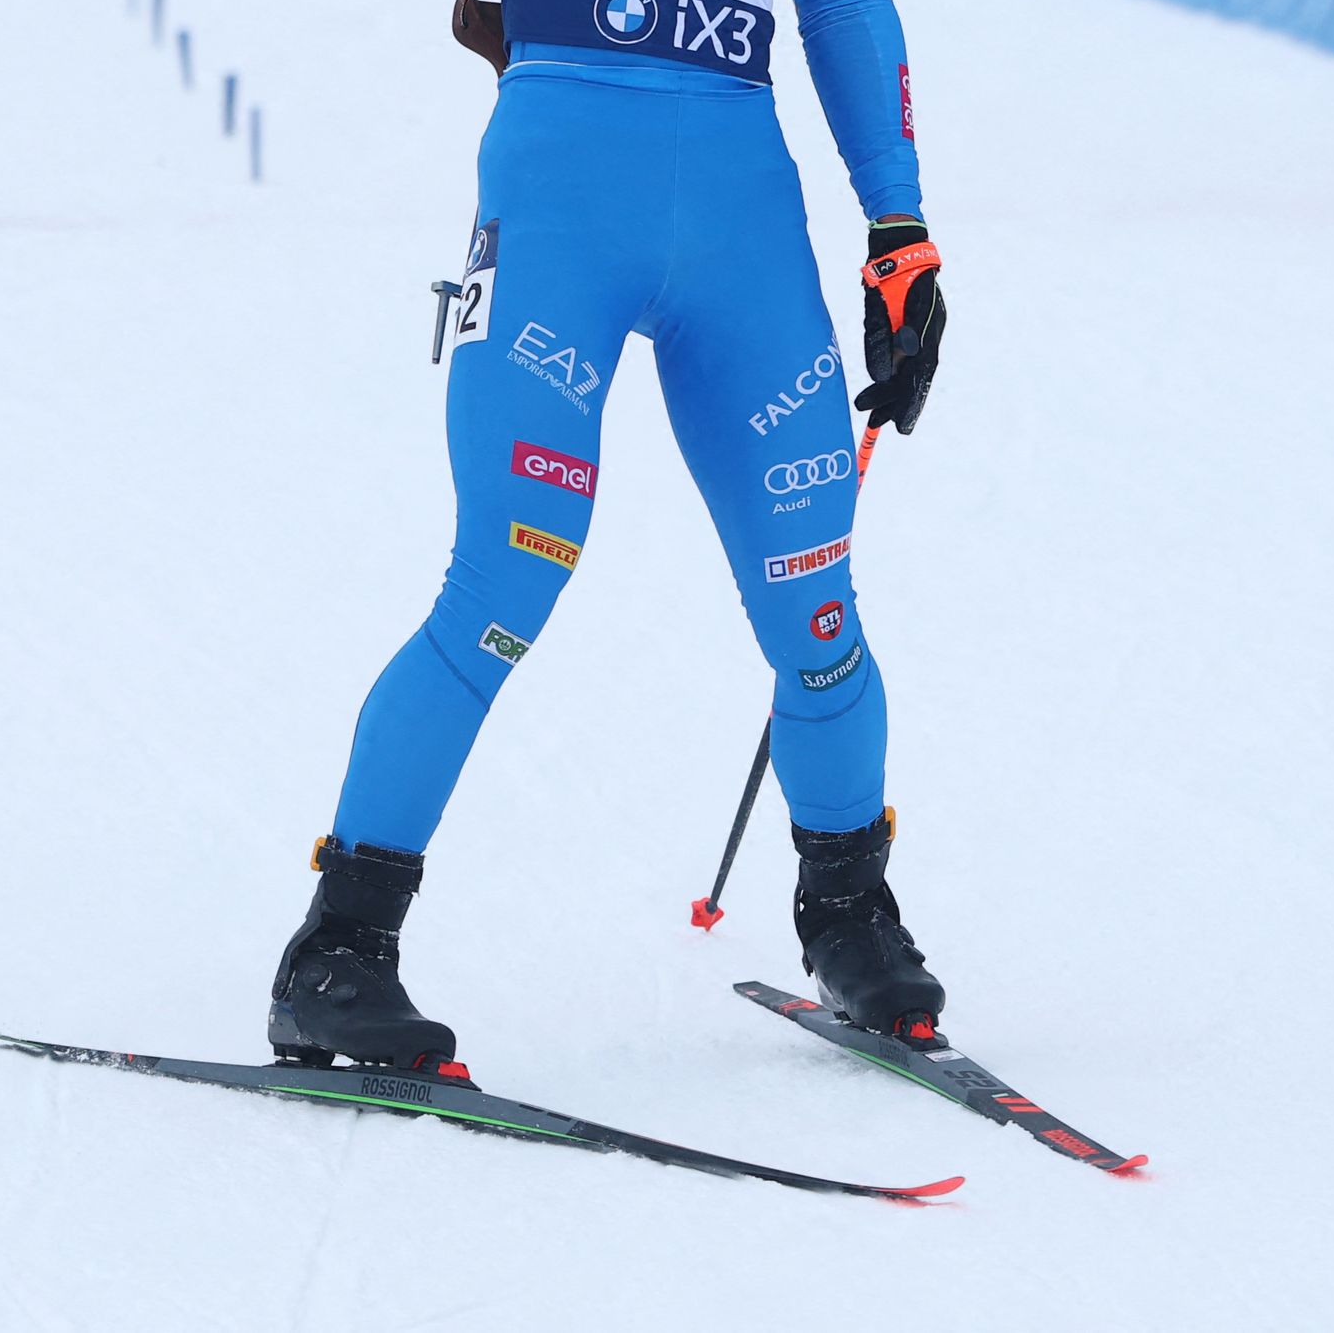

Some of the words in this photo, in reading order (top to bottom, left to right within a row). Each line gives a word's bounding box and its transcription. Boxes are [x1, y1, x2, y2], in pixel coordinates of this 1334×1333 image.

[455, 282, 483, 336] 2
[513, 321, 601, 397] EA7
[507, 350, 550, 381] EMPORIO
[556, 385, 591, 417] ARMANI
[524, 455, 591, 493] enel
[772, 496, 811, 514] Audi
[516, 528, 578, 565] PIRELLI
[818, 609, 841, 627] RTL
[361, 1076, 433, 1104] ROSSIGNOL
